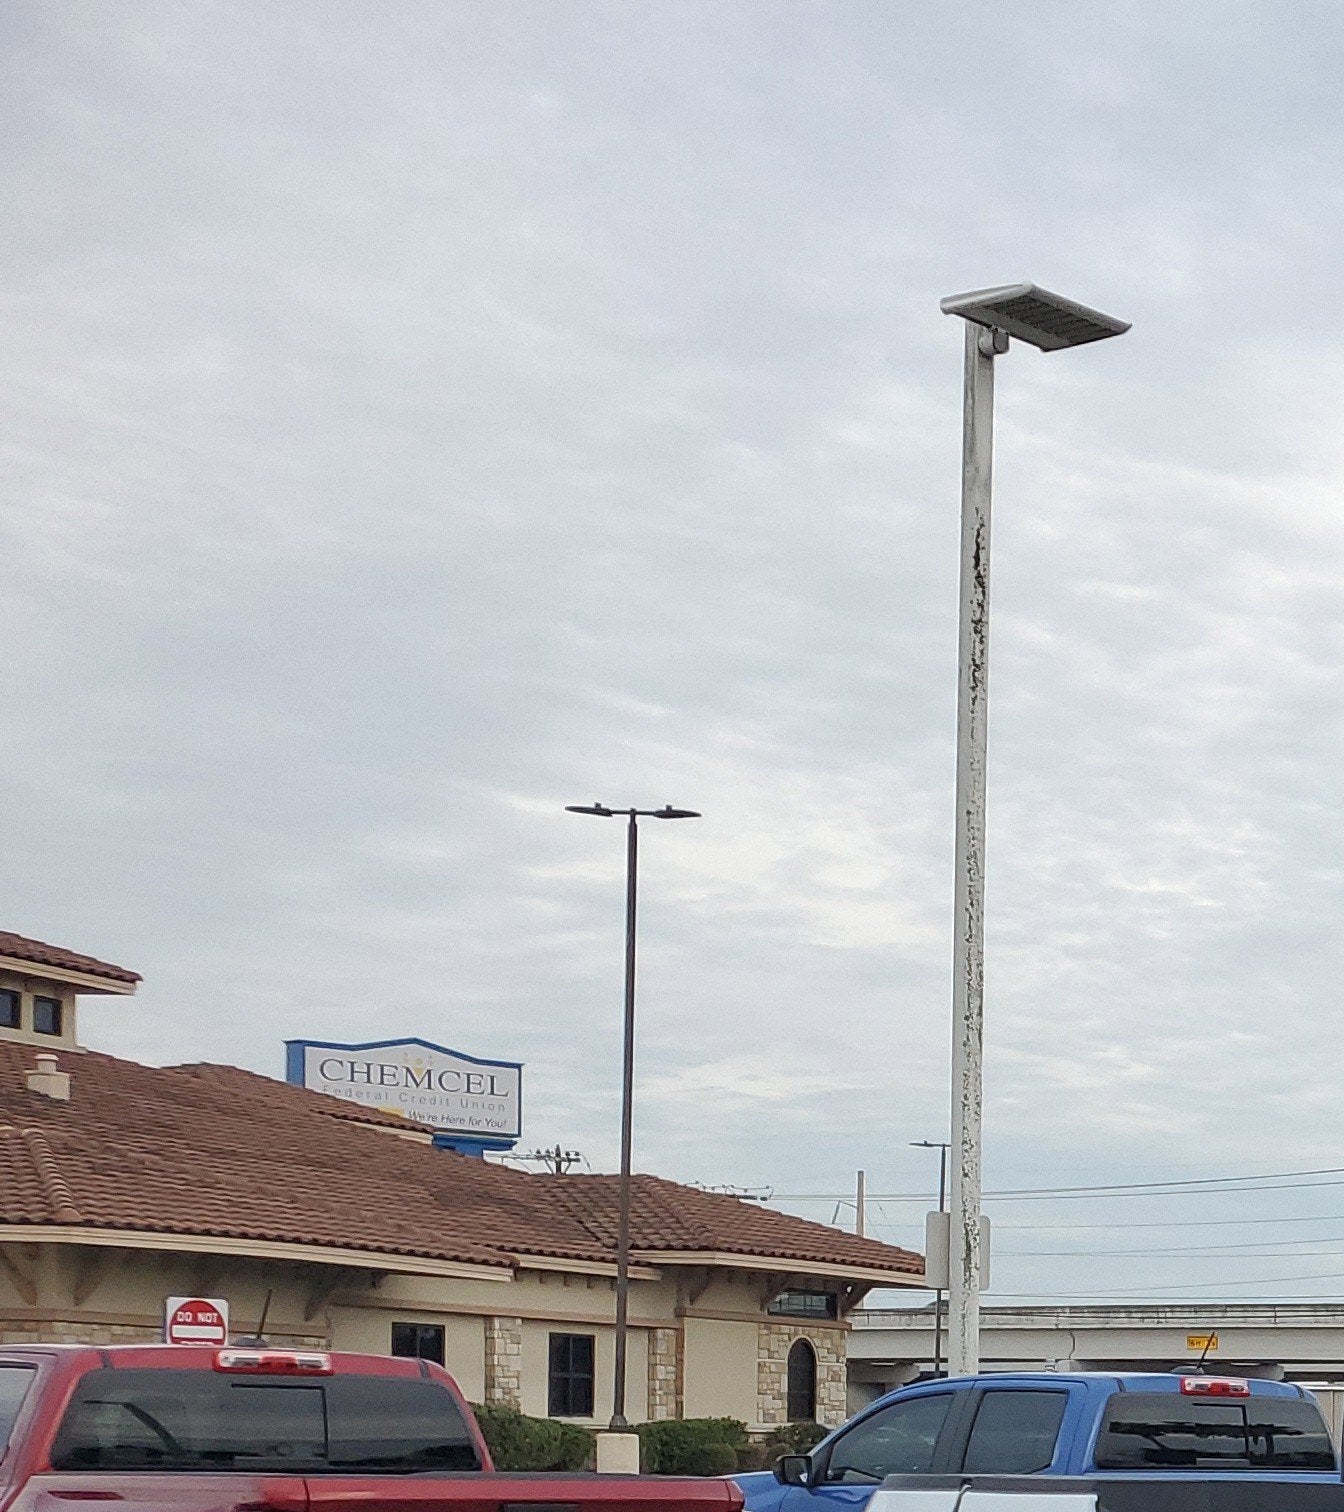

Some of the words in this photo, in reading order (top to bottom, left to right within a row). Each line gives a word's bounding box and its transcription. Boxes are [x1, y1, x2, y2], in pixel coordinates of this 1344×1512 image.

[319, 1058, 509, 1098] CHEMCEL
[323, 1085, 388, 1100] Federal
[399, 1091, 450, 1107] Credit
[460, 1097, 506, 1112] Union
[408, 1109, 439, 1122] We're
[440, 1113, 466, 1125] Here
[468, 1116, 482, 1126] for
[484, 1117, 507, 1129] You!
[176, 1311, 193, 1323] DO
[197, 1312, 218, 1323] NOT
